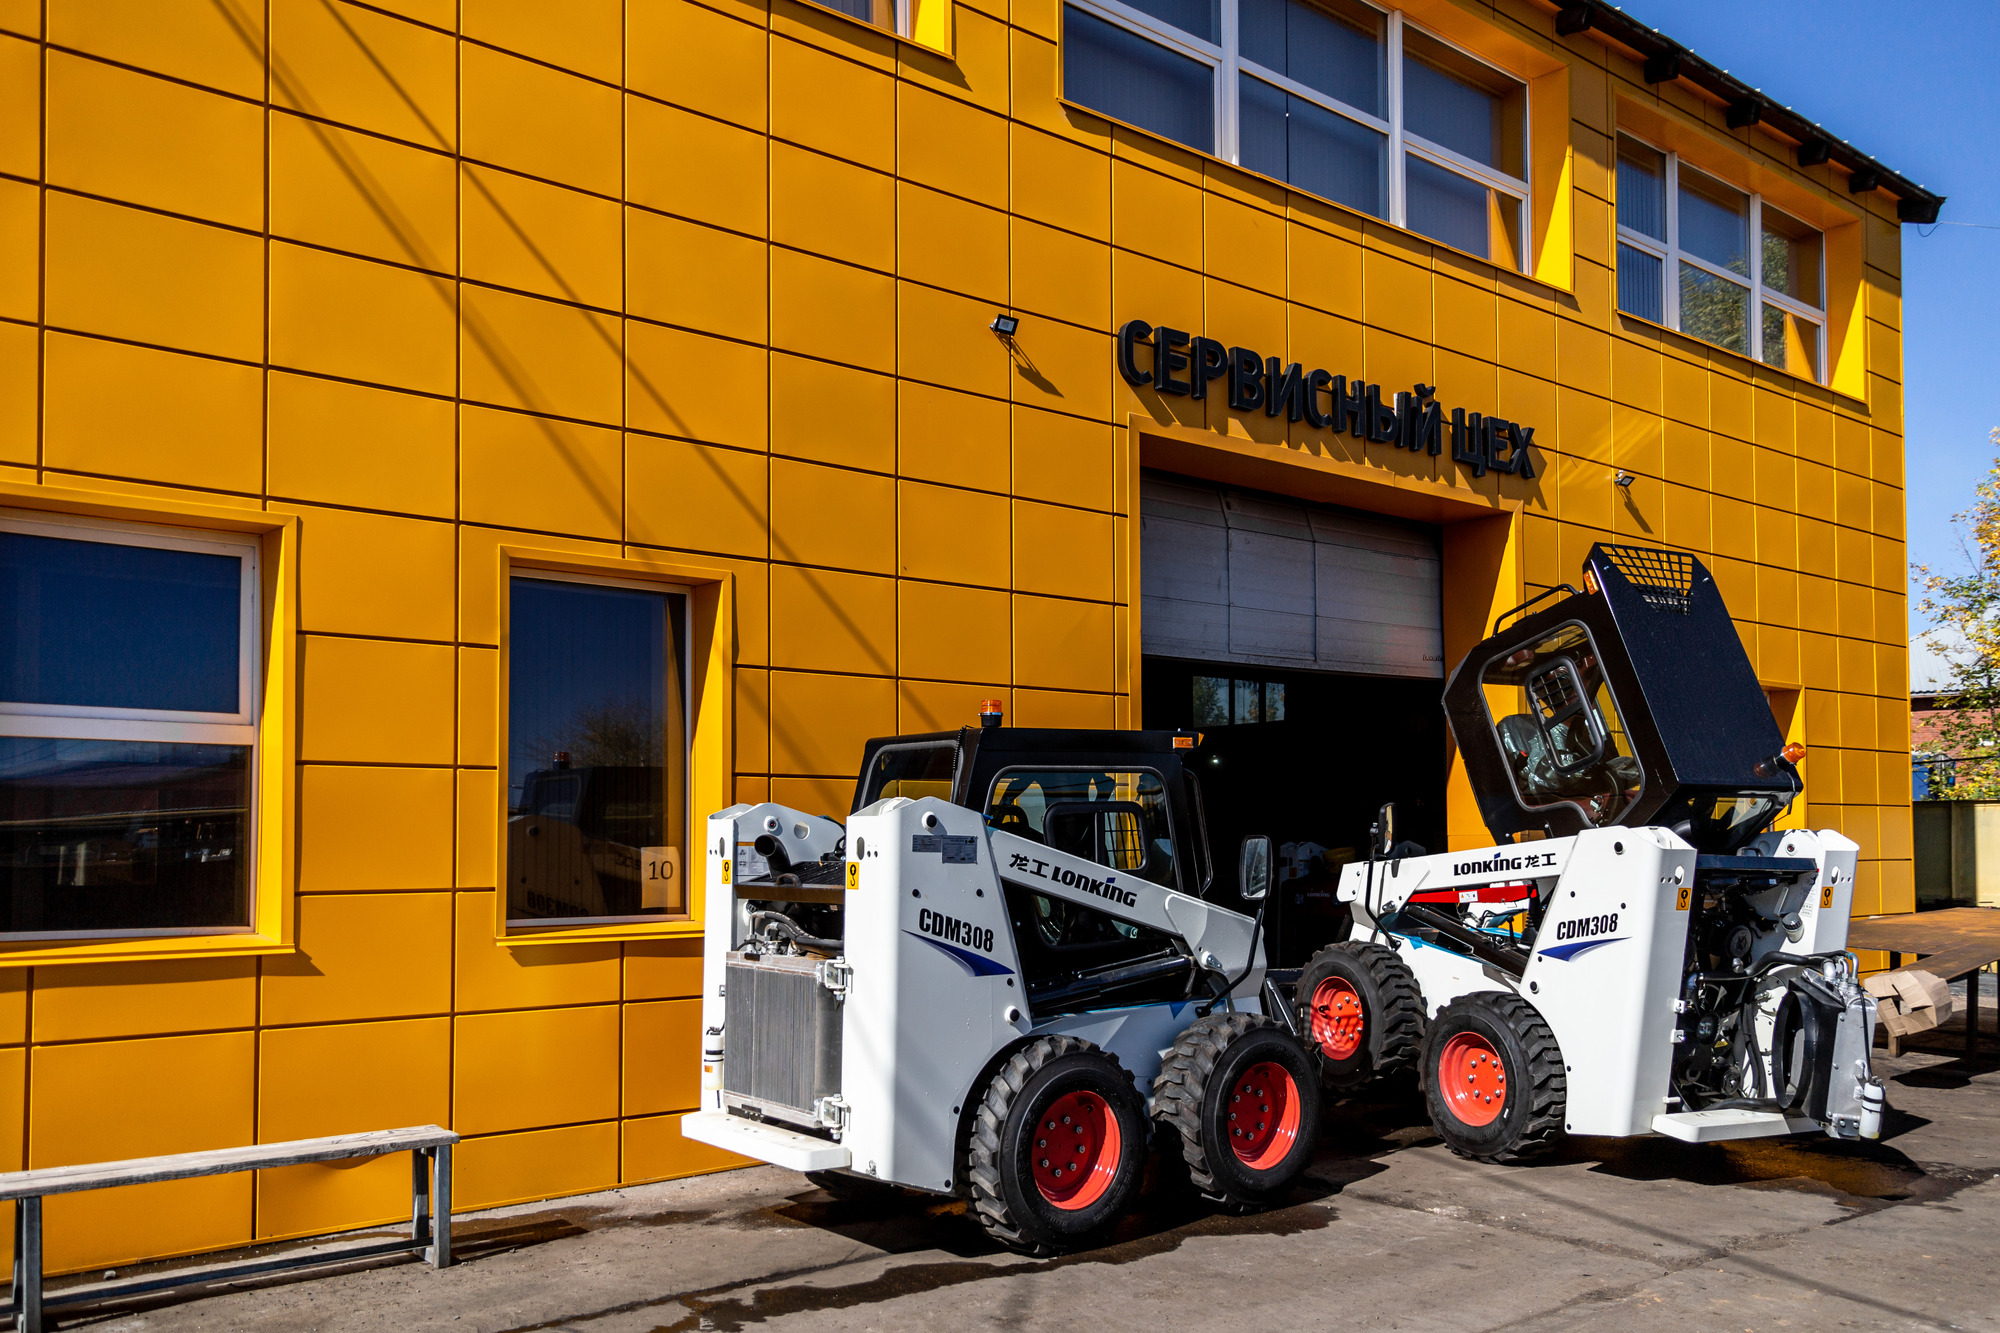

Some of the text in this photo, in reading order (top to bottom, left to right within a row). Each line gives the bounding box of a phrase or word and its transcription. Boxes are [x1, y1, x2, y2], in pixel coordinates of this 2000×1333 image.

[1118, 319, 1535, 479] СЕРВИСНЫЙ ЦЕХ
[648, 860, 674, 880] 10
[1009, 853, 1049, 878] 龙工
[1525, 853, 1557, 868] 龙工
[919, 908, 994, 953] CDM308
[1556, 912, 1618, 941] CDM308
